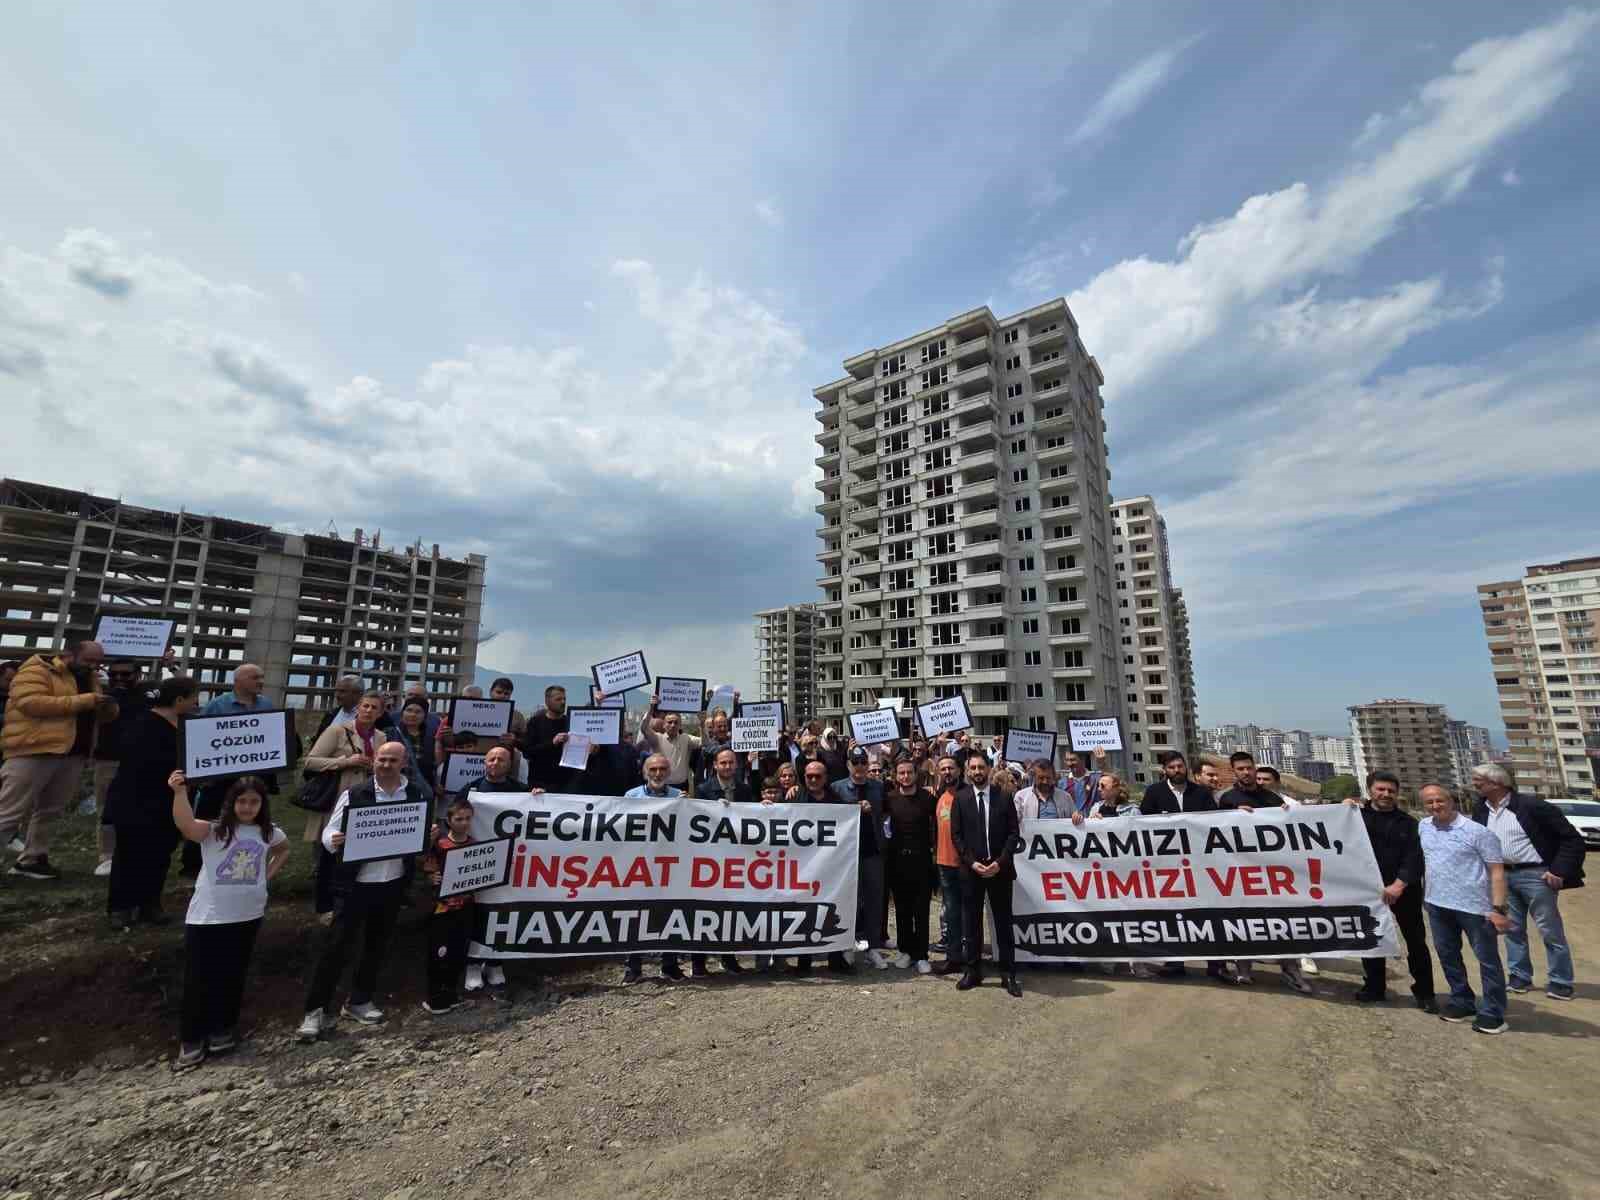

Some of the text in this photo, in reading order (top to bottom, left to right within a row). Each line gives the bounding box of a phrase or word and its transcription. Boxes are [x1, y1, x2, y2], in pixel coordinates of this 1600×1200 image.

[216, 718, 260, 730] MEKO
[211, 734, 265, 751] ÇÖZÜM
[195, 751, 281, 769] İSTİYORUZ
[356, 804, 420, 817] KORUŞEHİRDE
[354, 815, 420, 829] SÖZLEŞMELER
[494, 803, 837, 847] GECİKEN SADECE
[356, 827, 416, 839] UYGULANSIN
[1204, 821, 1343, 855] ALDIN,
[464, 846, 495, 860] MEKO
[456, 859, 496, 875] TESLİM
[512, 845, 821, 898] İNŞAAT DEĞİL,
[452, 873, 496, 891] NEREDE
[1041, 857, 1196, 902] EVİMİZİ
[1205, 865, 1299, 897] VER
[485, 904, 829, 945] HAYATLARIMIZ!
[1013, 912, 1366, 945] MEKO TESLİM NEREDE!
